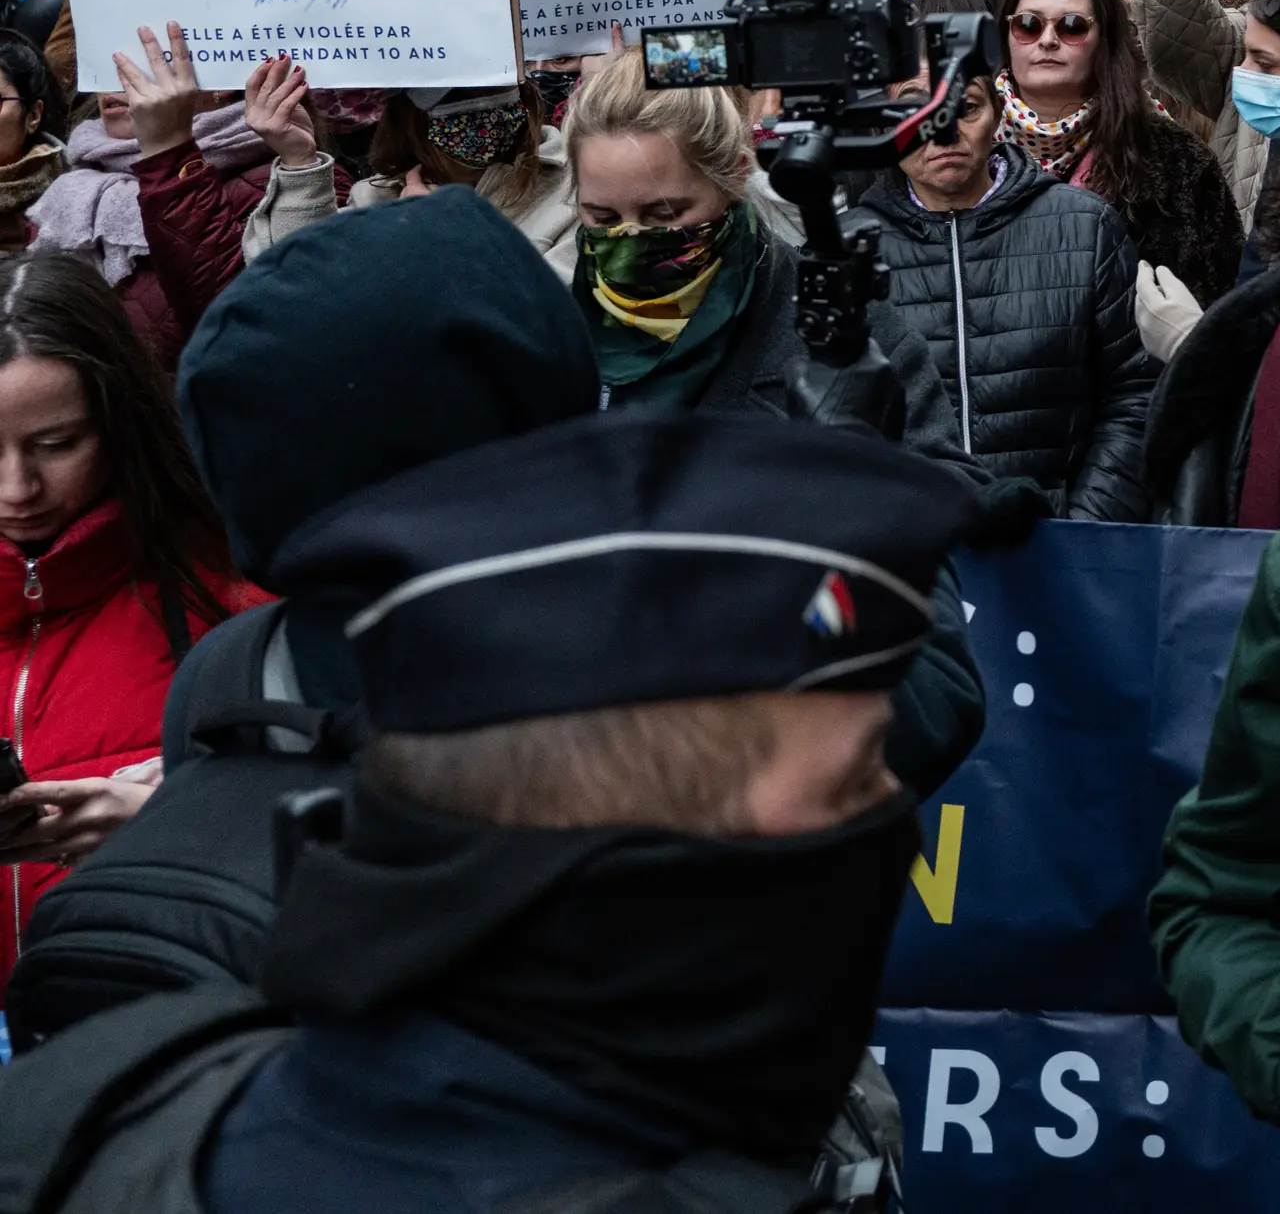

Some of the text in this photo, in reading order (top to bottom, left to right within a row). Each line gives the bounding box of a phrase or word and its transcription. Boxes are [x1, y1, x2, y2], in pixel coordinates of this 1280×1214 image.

[181, 23, 411, 41] ELLE A ÉTÉ VIOLÉE PAR
[279, 46, 447, 62] PENDANT 10 ANS
